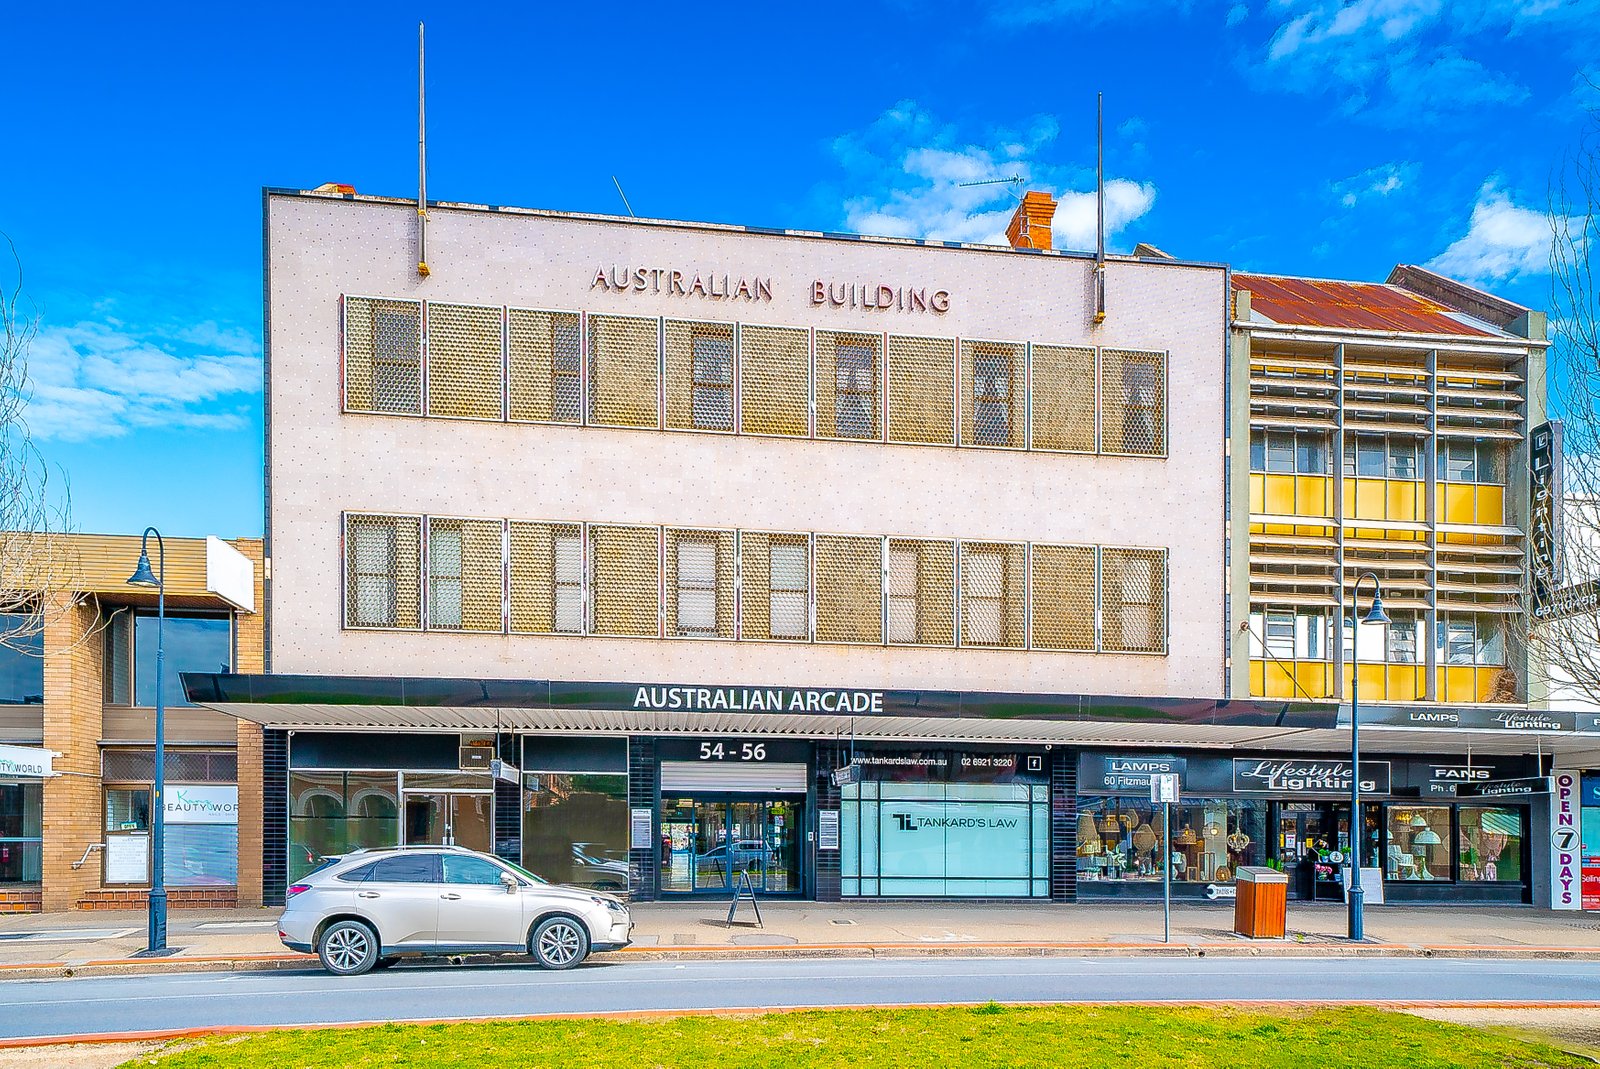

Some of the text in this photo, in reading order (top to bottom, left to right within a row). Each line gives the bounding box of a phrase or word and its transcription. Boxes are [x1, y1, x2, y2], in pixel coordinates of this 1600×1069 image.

[591, 263, 951, 313] AUSTRALIAN BUILDING
[633, 686, 884, 713] AUSTRALIAN ARCADE
[1410, 713, 1459, 722] LAMPS
[1491, 712, 1552, 723] Lifestyle
[1504, 720, 1561, 730] Lighting
[699, 742, 725, 760] 54
[741, 743, 766, 760] 56
[850, 756, 948, 766] www.tankardslaw.com.au
[961, 758, 971, 766] 02
[973, 758, 991, 766] 6921
[993, 758, 1013, 767] 3220
[1111, 762, 1170, 772] LAMPS
[0, 763, 11, 772] TY
[15, 764, 43, 774] WORLD
[1241, 760, 1353, 780] Lifestyle
[1435, 769, 1490, 779] FANS
[1104, 776, 1152, 786] 60 Fitzmau
[1481, 786, 1532, 795] Lighting
[917, 817, 987, 828] TANKARD'S
[989, 818, 1018, 828] LAW
[1557, 774, 1574, 905] OPEN 7 DAYS
